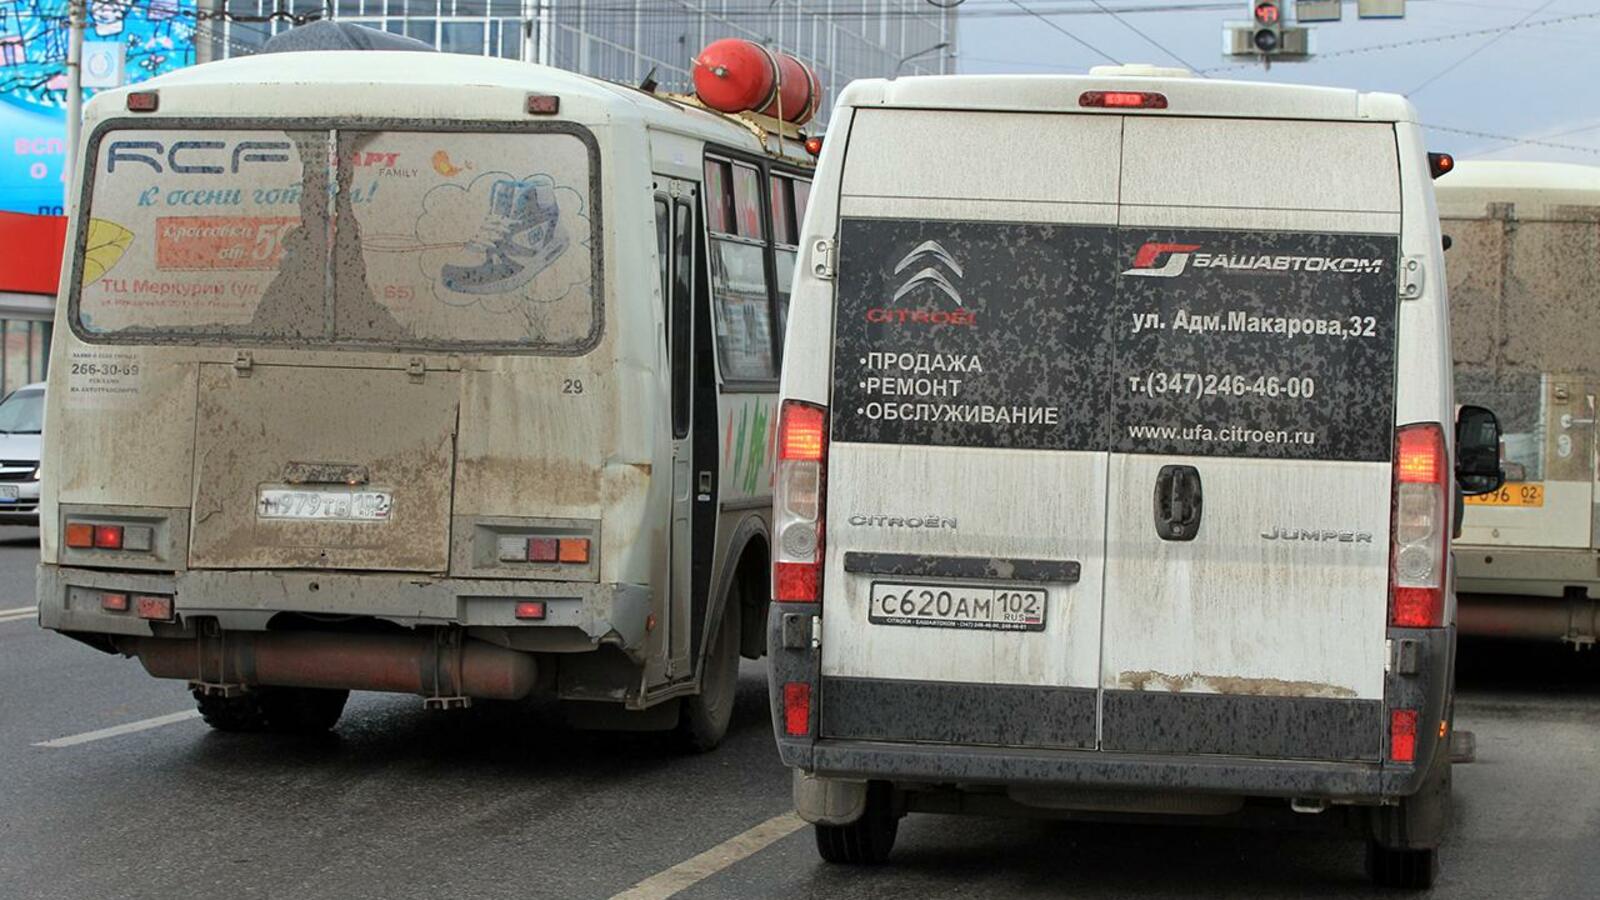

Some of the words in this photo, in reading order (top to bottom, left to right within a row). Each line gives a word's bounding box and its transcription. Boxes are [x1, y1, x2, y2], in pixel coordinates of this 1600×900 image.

[107, 141, 291, 174] RCF
[378, 168, 418, 178] FAMILY
[1192, 253, 1384, 273] БАШАВТОКОМ
[101, 278, 128, 295] ТЦ
[132, 279, 225, 297] Меркурий
[1131, 312, 1166, 333] ул.
[1172, 309, 1377, 340] Адм.Макарова,32
[71, 363, 140, 376] 266-30-69
[562, 379, 584, 394] 29
[1128, 372, 1315, 399] т.(347)246-46-00
[1128, 424, 1315, 445] www.ufa.citroen.ru
[1520, 486, 1538, 500] 02
[1260, 525, 1374, 544] JUMPER
[996, 592, 1037, 614] 102
[1003, 613, 1025, 622] RUS
